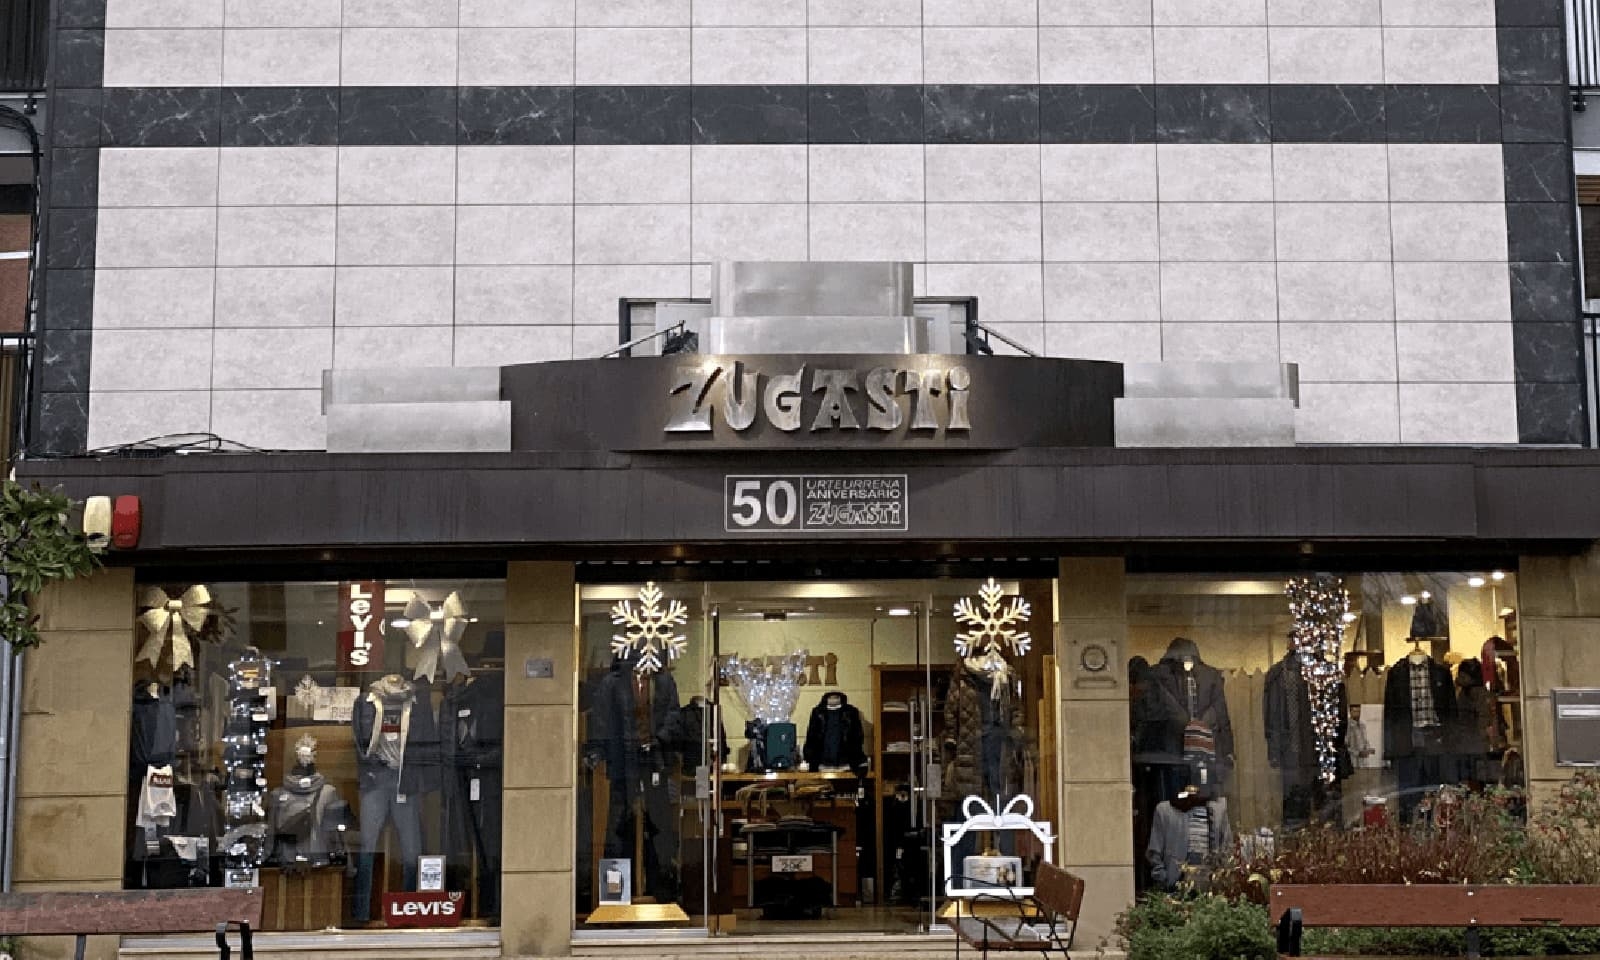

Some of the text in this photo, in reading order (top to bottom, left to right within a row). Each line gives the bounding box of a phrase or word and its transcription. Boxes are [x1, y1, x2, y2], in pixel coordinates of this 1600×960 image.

[806, 480, 900, 490] URTEURRENA
[806, 489, 901, 499] ANIVERSARIO
[732, 480, 797, 526] 50
